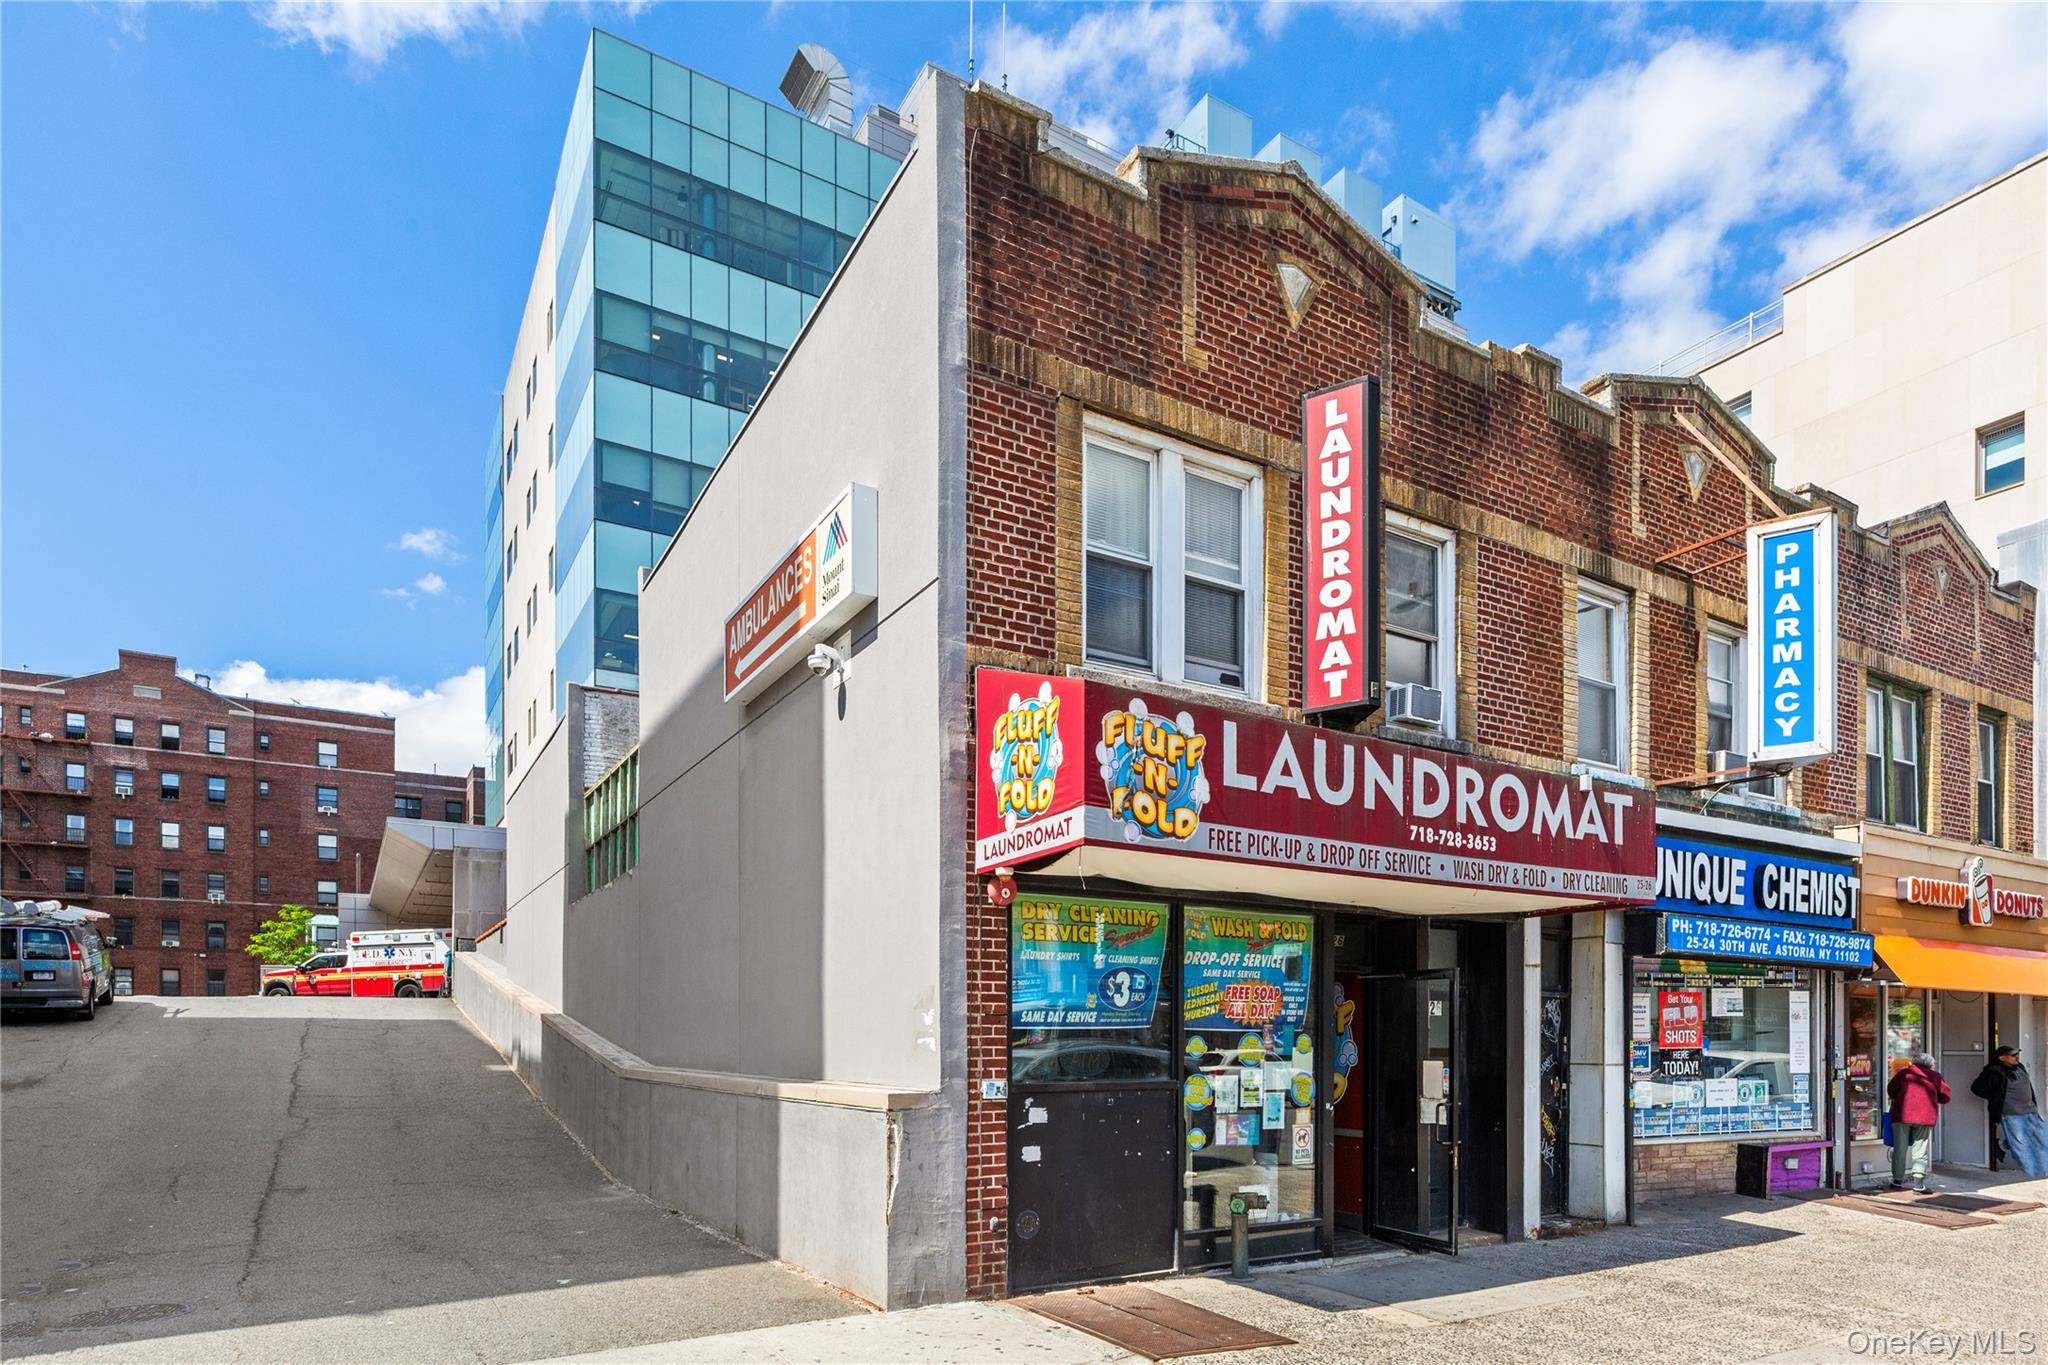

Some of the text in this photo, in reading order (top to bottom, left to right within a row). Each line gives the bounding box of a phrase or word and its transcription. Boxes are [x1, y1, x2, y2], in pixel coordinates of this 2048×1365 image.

[1315, 399, 1356, 698] LAUNDROMAT
[822, 557, 845, 587] Mount
[729, 546, 812, 658] AMBULANCES
[822, 579, 841, 607] Sinai
[1772, 542, 1802, 737] PHARMACY
[994, 697, 1060, 749] FLUFF
[1104, 712, 1204, 769] FLUFF
[1223, 720, 1633, 845] LAUNDROMAT
[999, 778, 1055, 816] FOLD
[1111, 786, 1198, 839] FOLD
[984, 816, 1072, 861] LAUNDROMAT
[1410, 825, 1497, 852] 718-728-3653
[1208, 828, 1628, 895] FREE PICK-UP & DROP OFF SERVICE WASH DRY & FOLD DRY CLEANING
[1762, 863, 1860, 919] CHEMIST
[1911, 878, 2044, 918] DUNKIN' DONUTS
[1021, 902, 1160, 928] DRY CLEANING
[1022, 922, 1098, 943] SERVICE
[1210, 916, 1254, 938] WASH
[1273, 920, 1308, 942] FOLD
[1671, 918, 1693, 934] PH:
[1696, 922, 1771, 941] 718-726-6774
[1783, 929, 1806, 945] FAX:
[1808, 932, 1871, 951] 718-726-9874
[1020, 951, 1080, 960] LAUNDRY SHIRTS
[1108, 954, 1138, 964] CLEANING
[1139, 956, 1160, 965] SHIRTS
[1184, 950, 1282, 968] DROP-OFF SERVICE
[1686, 936, 1859, 962] 25-24 30TH AVE. ASTORIA NY 11102
[1203, 968, 1261, 979] SAME DAY SERVICE
[1131, 993, 1146, 1001] EACH
[1187, 981, 1218, 997] TUESDAY
[1224, 985, 1281, 1002] FREE SOAP
[1667, 994, 1694, 1004] Get Your
[1021, 1011, 1098, 1023] SAME DAY SERVICE
[1225, 1002, 1275, 1018] ALL DAY!
[1663, 1005, 1698, 1028] FLU
[1665, 1030, 1697, 1044] SHOTS
[1672, 1050, 1689, 1059] HERE
[1663, 1061, 1699, 1075] TODAY!
